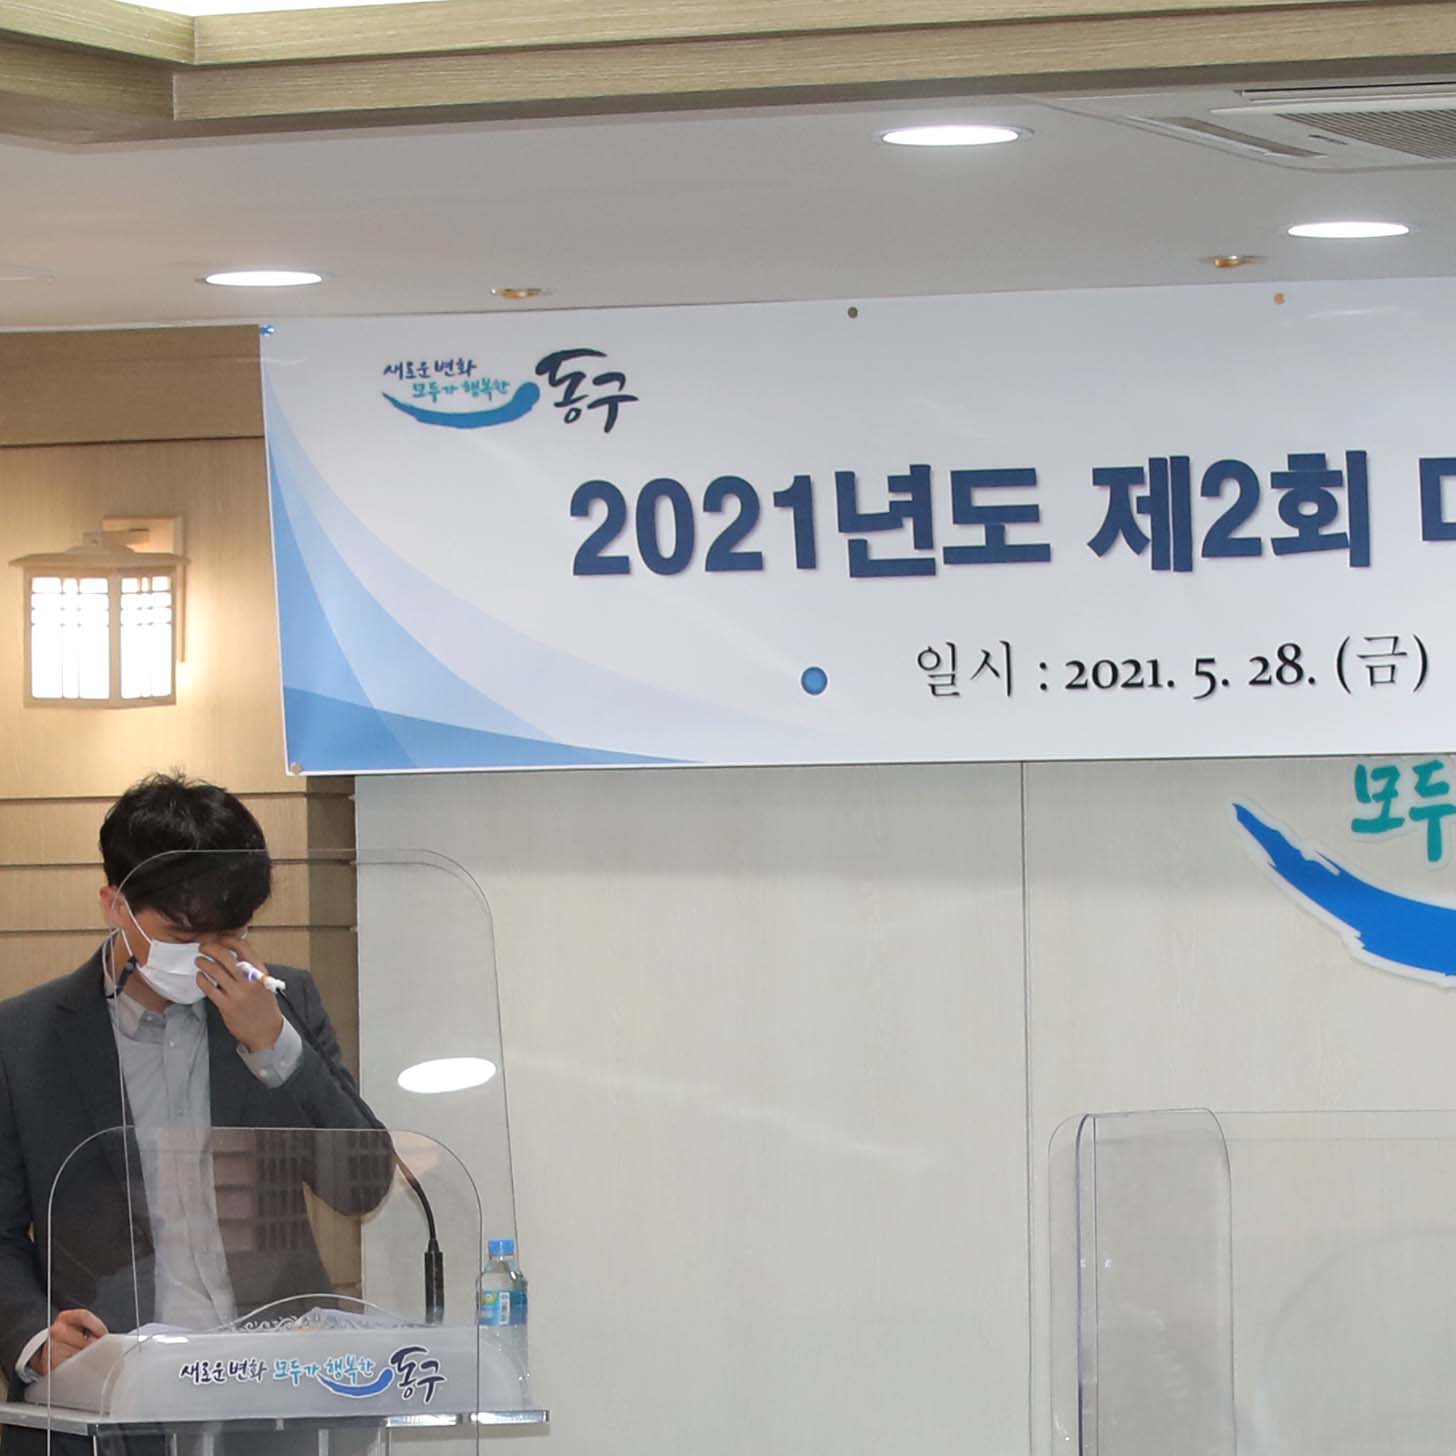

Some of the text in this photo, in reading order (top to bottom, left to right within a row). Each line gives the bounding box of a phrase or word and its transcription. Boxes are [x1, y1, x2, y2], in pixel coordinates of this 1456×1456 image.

[383, 357, 477, 381] 새로운 변화
[412, 377, 511, 403] 모두가 행복한
[534, 347, 639, 434] 동구
[569, 463, 1053, 579] 2021년도
[1086, 449, 1373, 573] 제2회
[916, 640, 1015, 698] 일시
[1065, 657, 1176, 692] 2021.
[1193, 657, 1230, 700] 5.
[1248, 642, 1317, 687] 28.
[1336, 635, 1429, 694] (금)
[180, 1346, 446, 1403] 새로운 변화 모두가 행복한 동구
